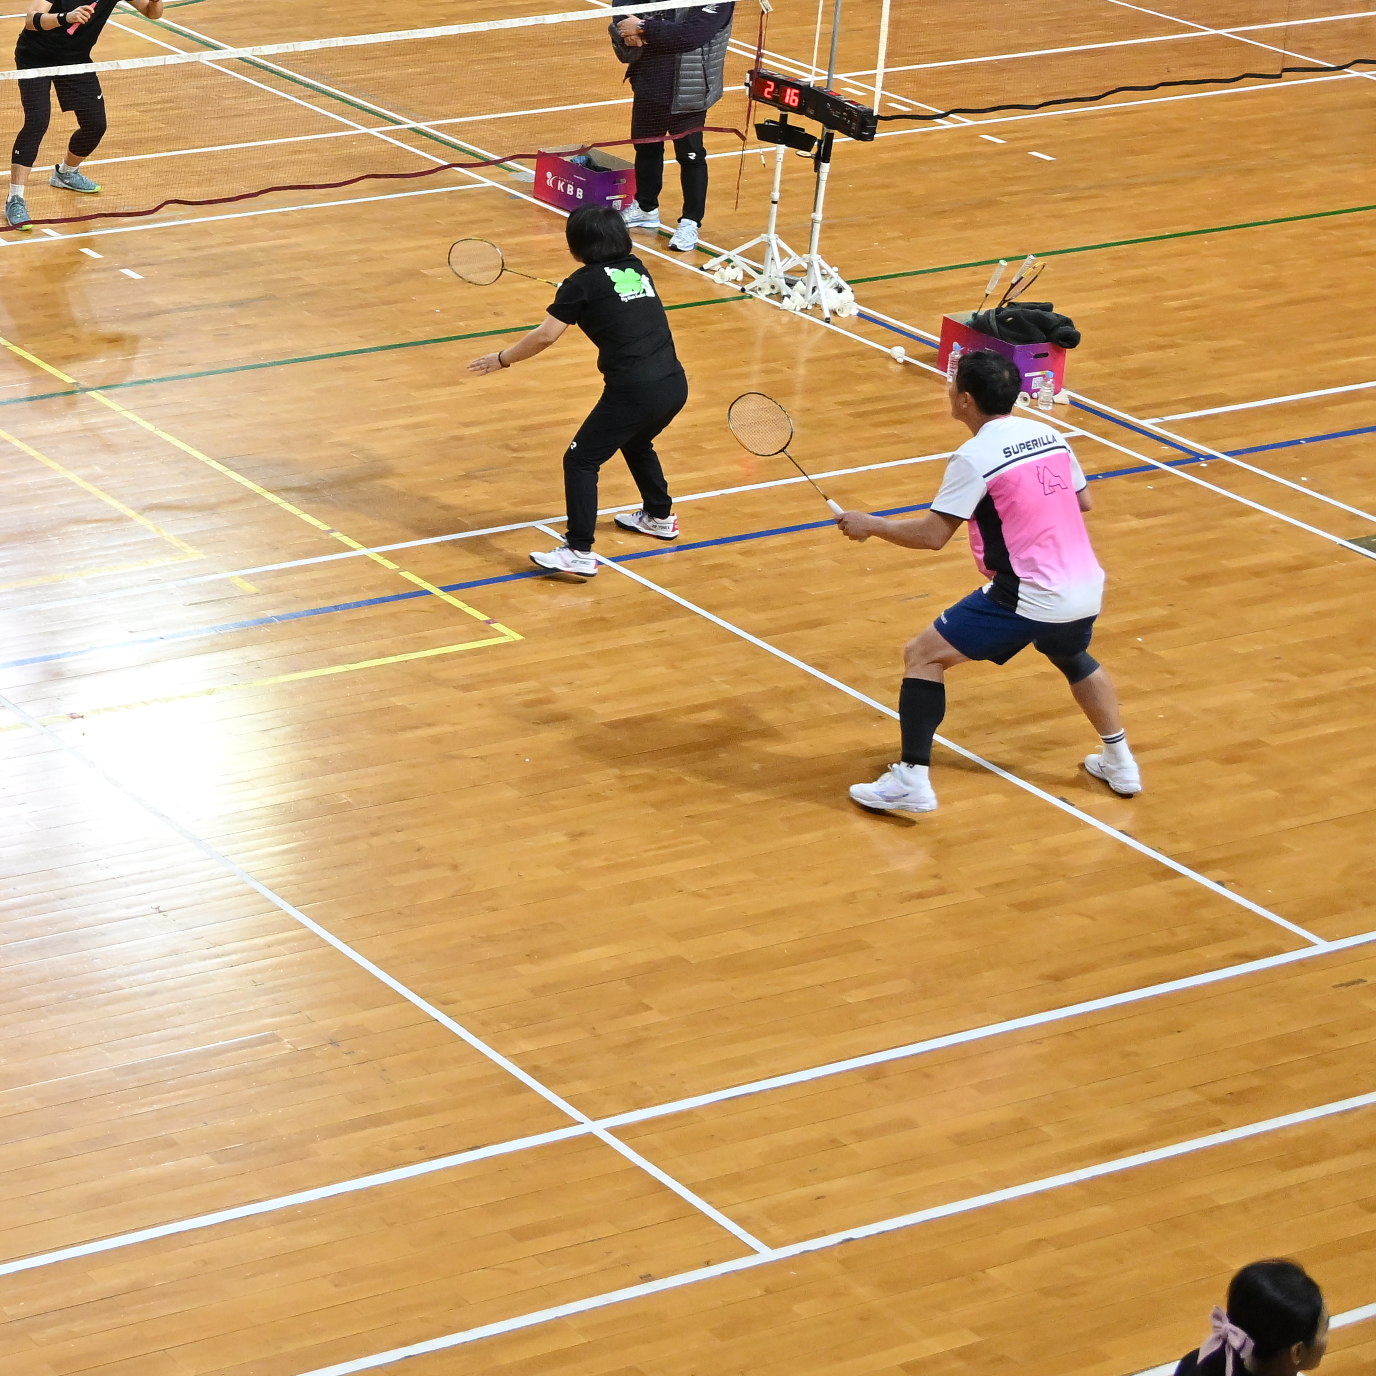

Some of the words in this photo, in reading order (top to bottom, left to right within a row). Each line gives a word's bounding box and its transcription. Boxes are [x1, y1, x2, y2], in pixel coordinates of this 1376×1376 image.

[763, 80, 775, 99] 2
[784, 88, 800, 107] 16
[557, 178, 584, 200] KBB
[1002, 433, 1058, 458] SUPERILLA
